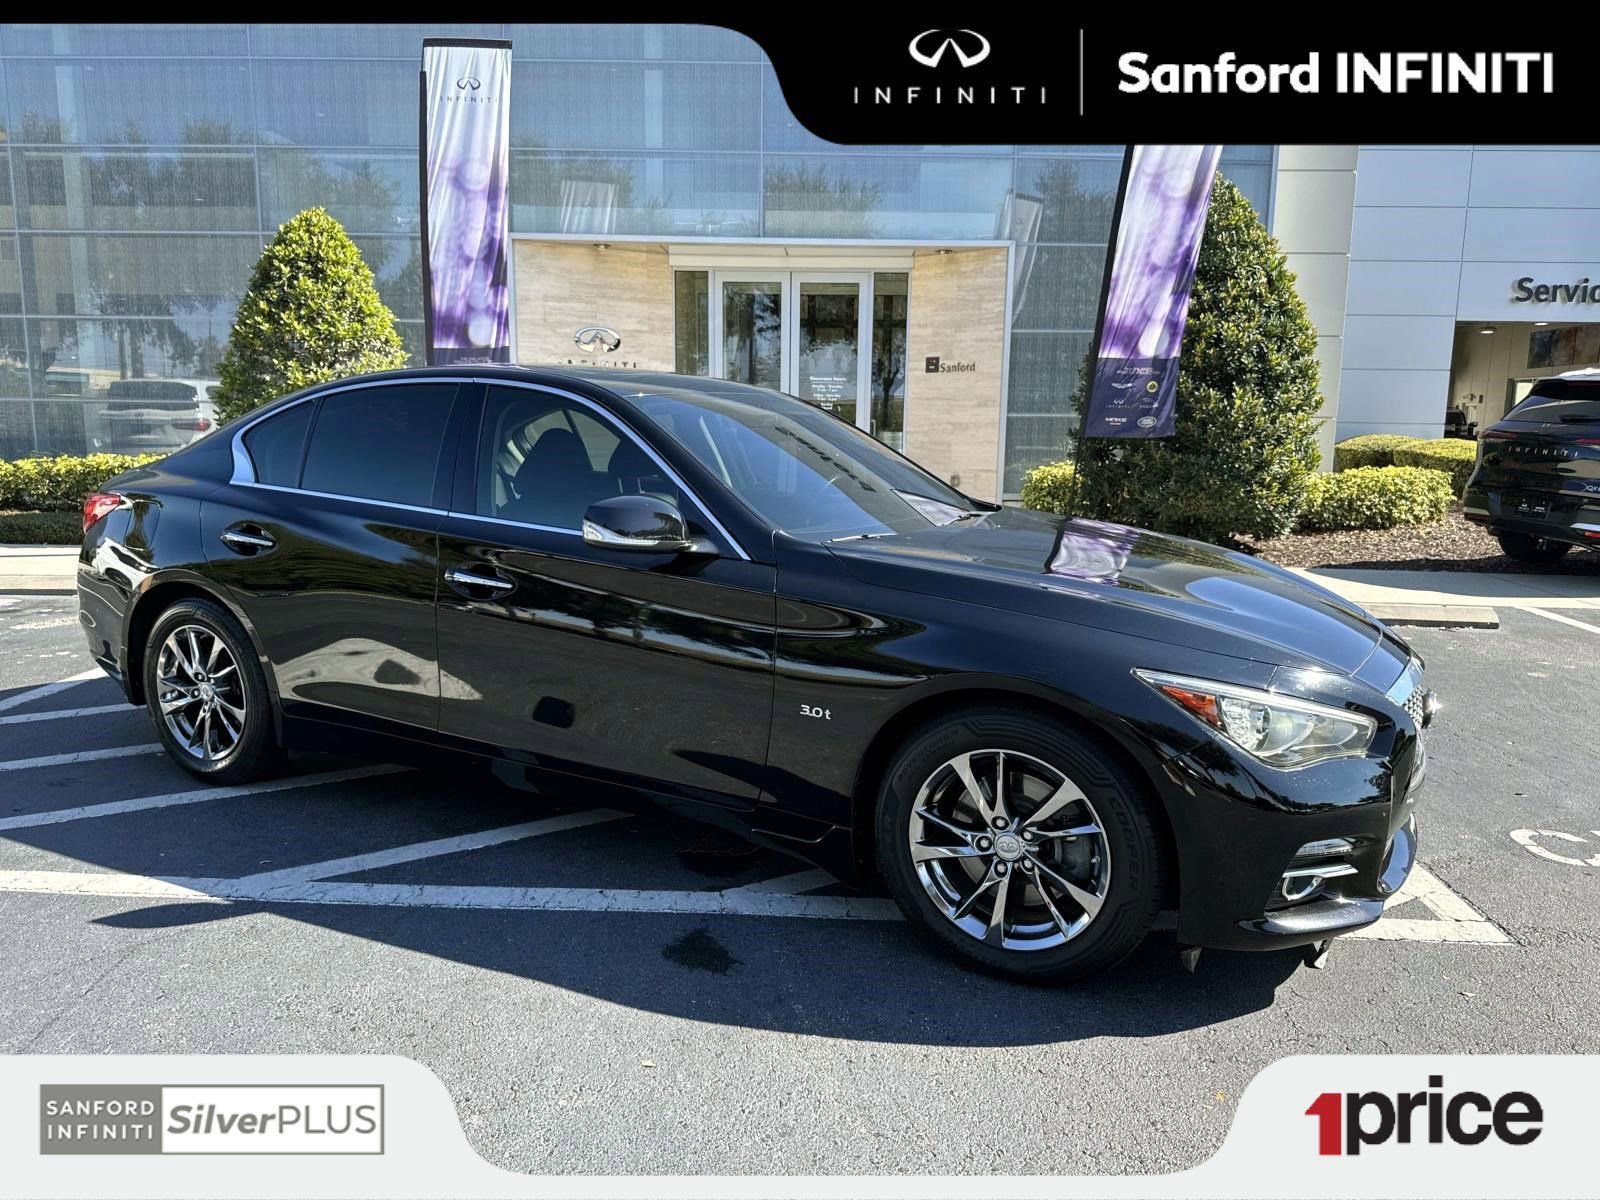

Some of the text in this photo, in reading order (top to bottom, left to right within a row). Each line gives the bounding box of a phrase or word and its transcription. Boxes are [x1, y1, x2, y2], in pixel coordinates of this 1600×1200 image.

[1515, 277, 1600, 303] Servic
[940, 361, 976, 373] Sanford
[1508, 446, 1578, 457] INFINITI
[1109, 797, 1139, 890] COOPER
